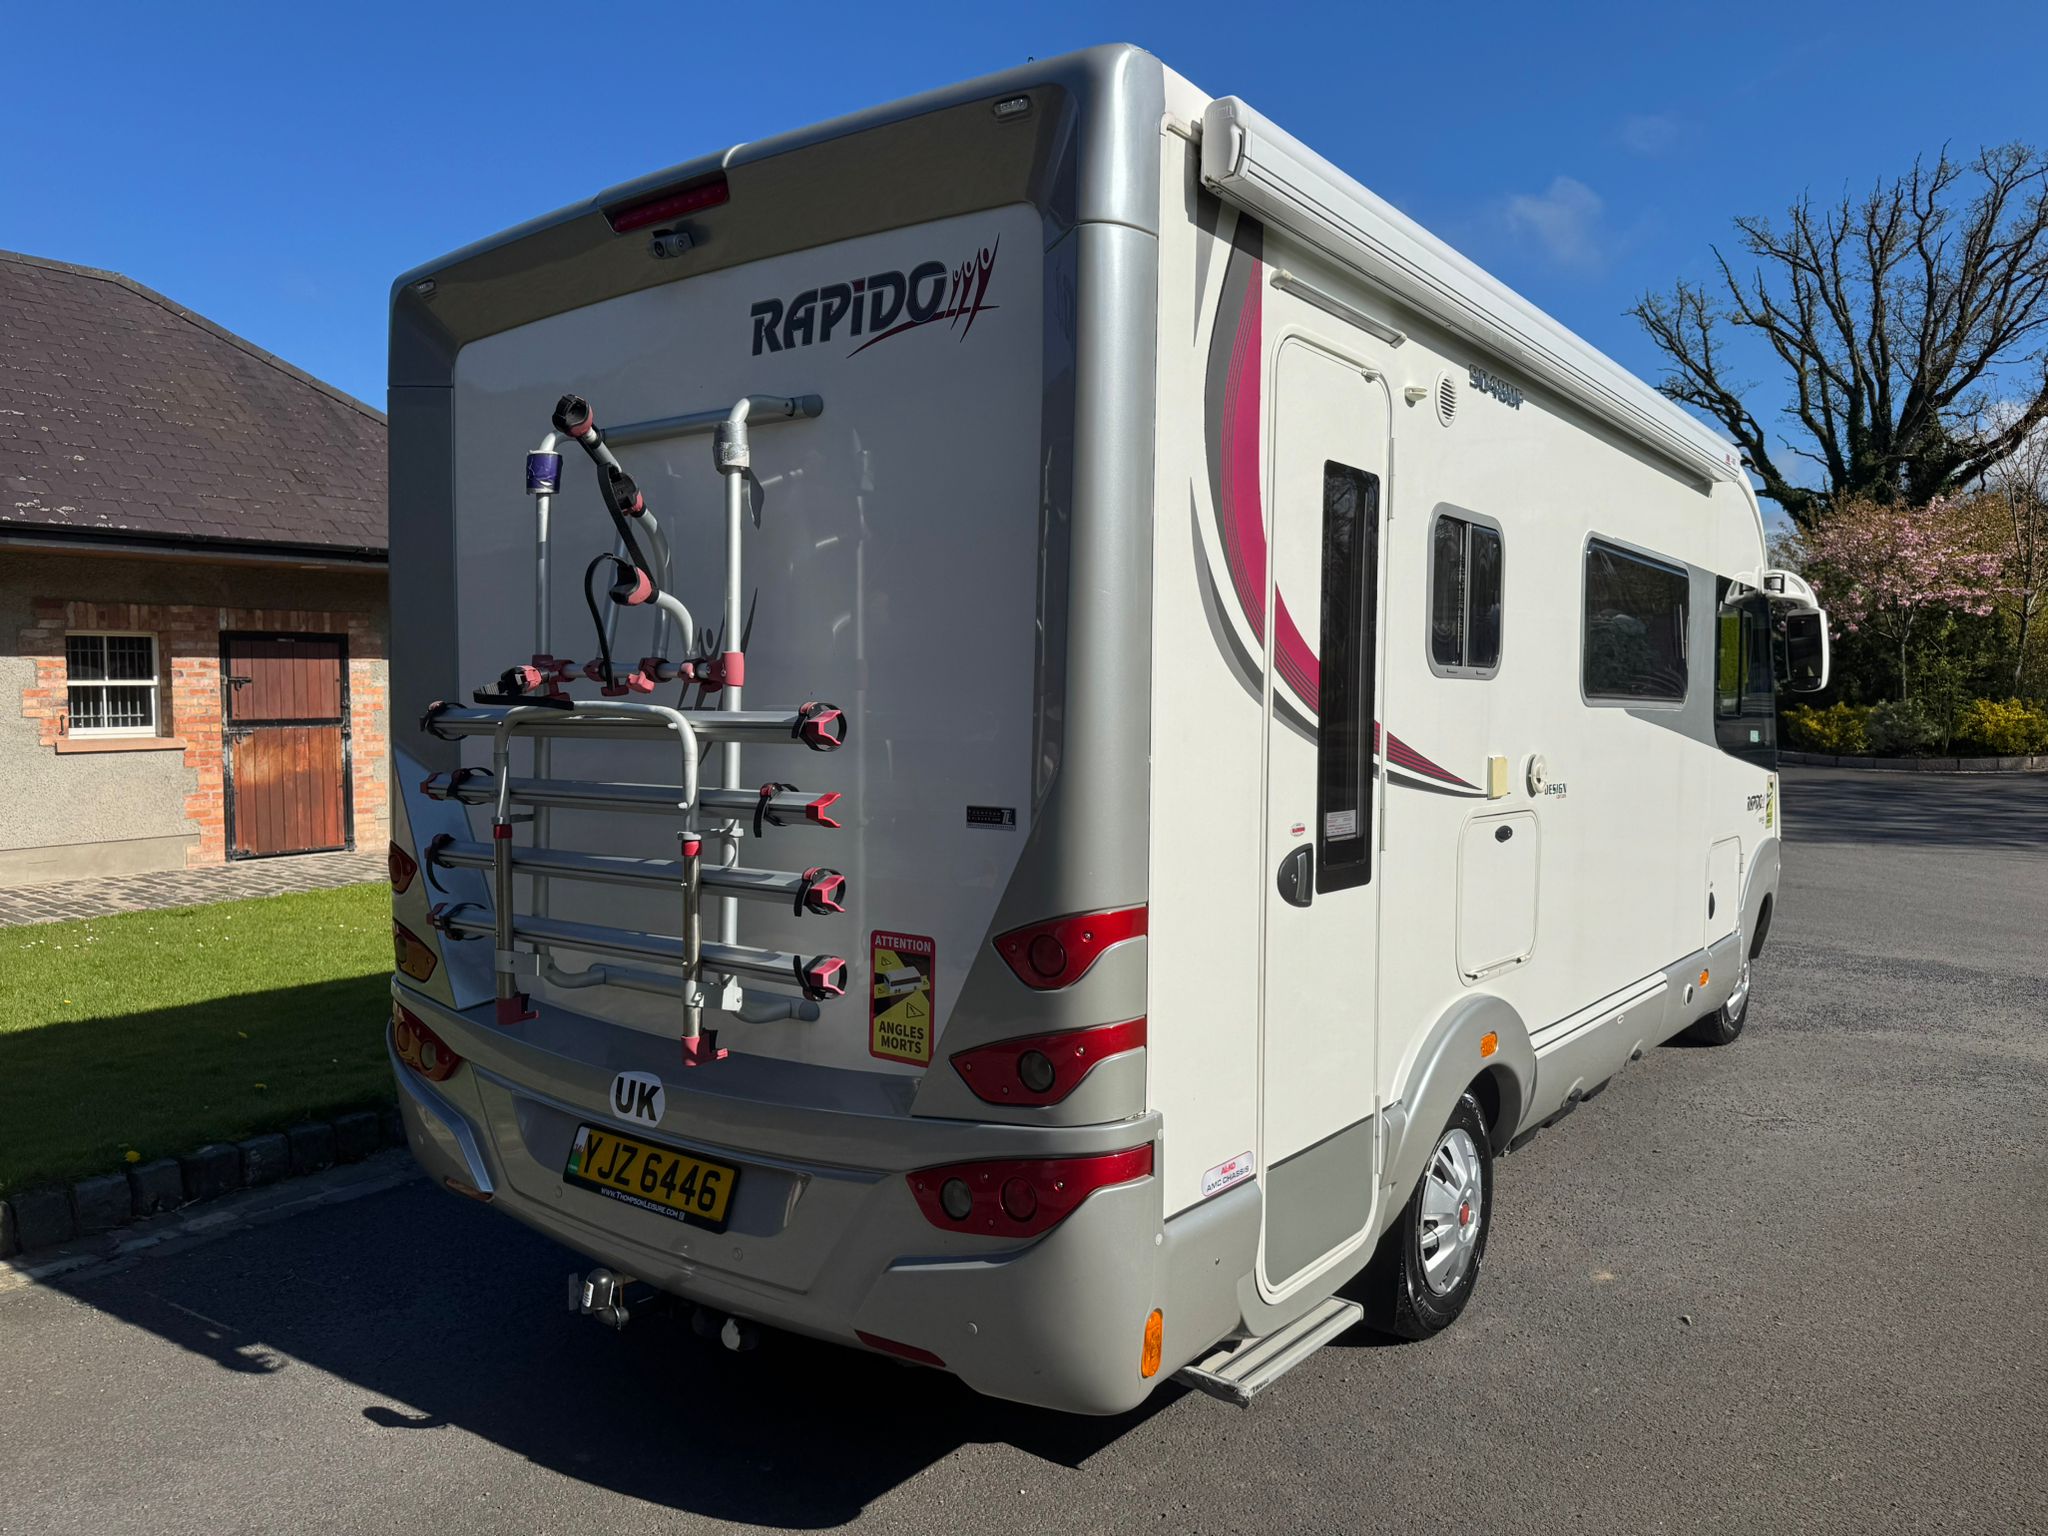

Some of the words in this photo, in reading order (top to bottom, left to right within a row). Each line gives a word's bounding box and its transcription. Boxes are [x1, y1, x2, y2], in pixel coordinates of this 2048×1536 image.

[1544, 783, 1567, 795] DESIGN
[875, 935, 932, 953] ATTENTION
[879, 1020, 925, 1040] ANGLES
[880, 1034, 922, 1054] MORTS
[615, 1076, 661, 1121] UK
[583, 1134, 639, 1187] YJZ
[640, 1153, 721, 1213] 6446
[1206, 1179, 1222, 1192] AMC
[1222, 1165, 1250, 1184] CHASSIS
